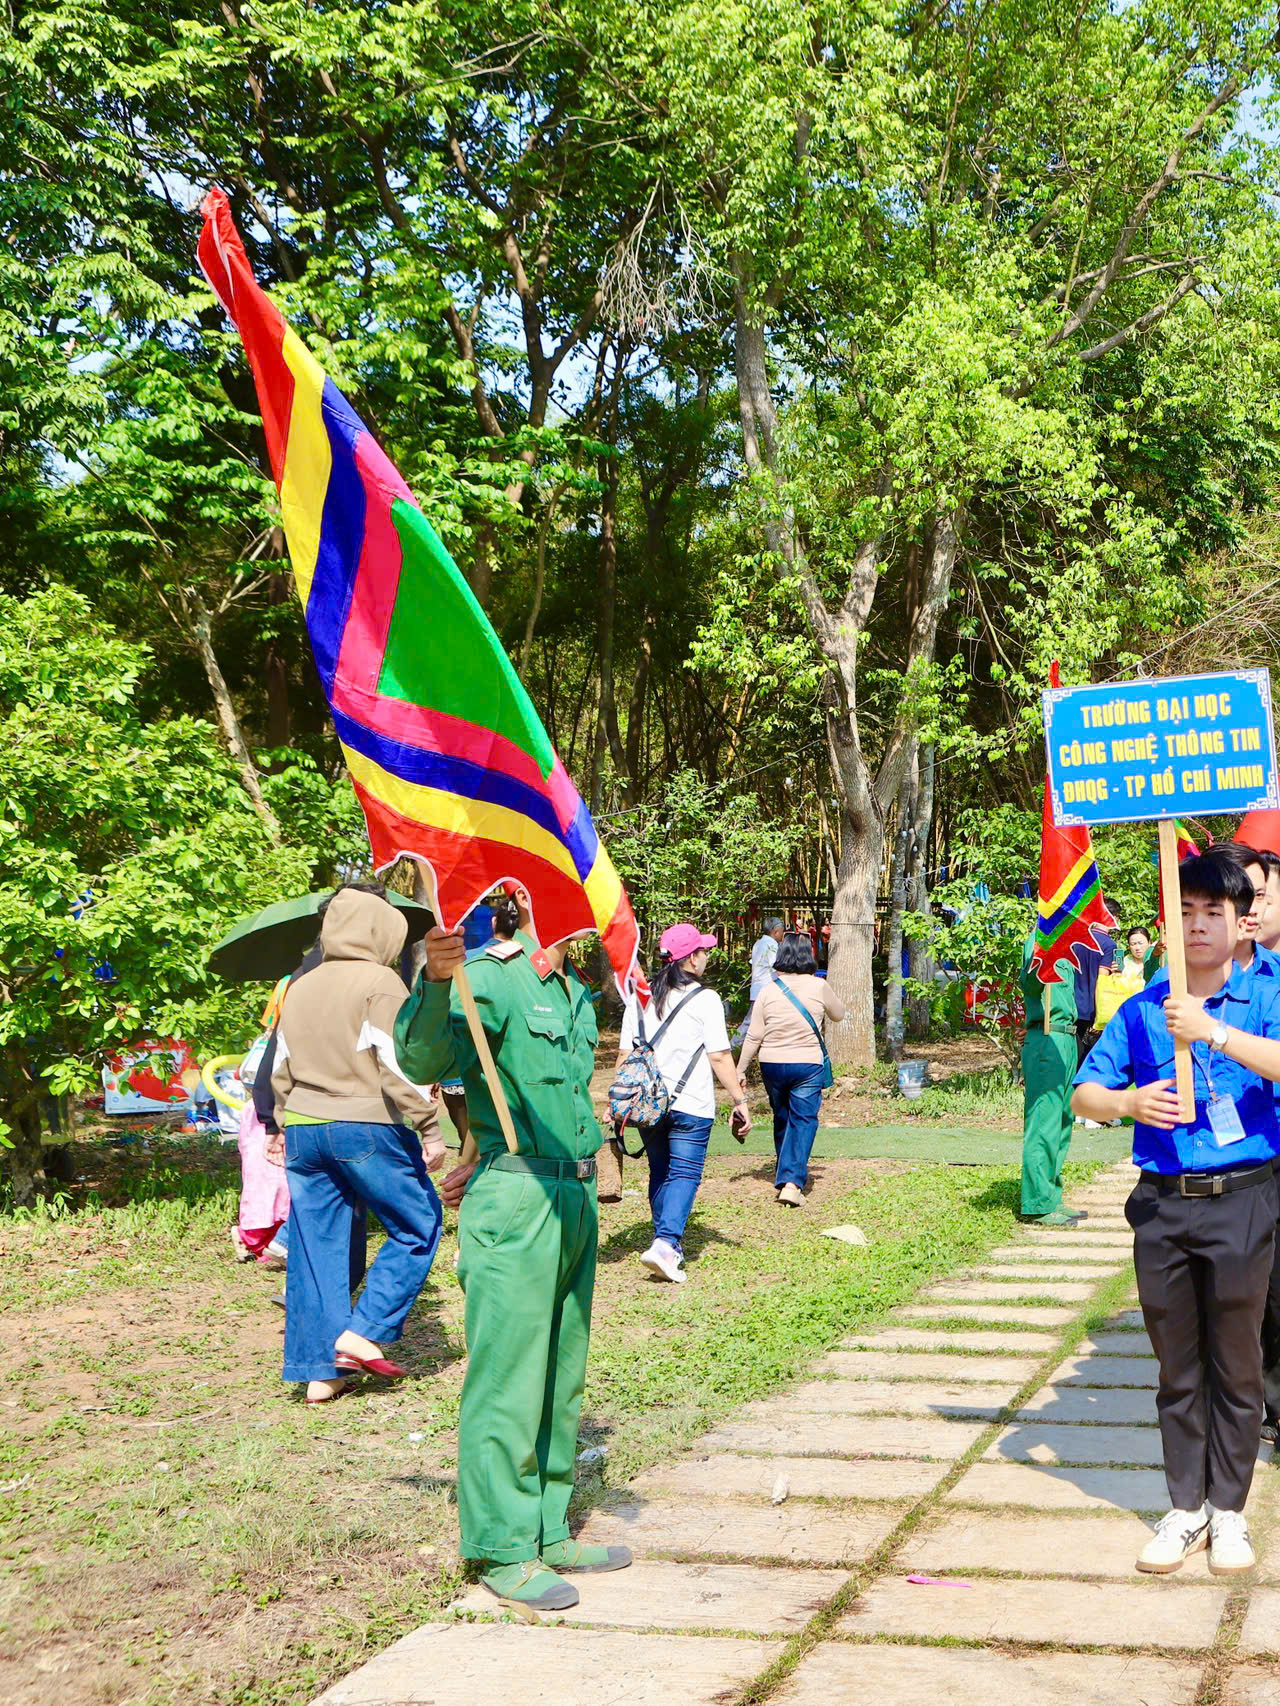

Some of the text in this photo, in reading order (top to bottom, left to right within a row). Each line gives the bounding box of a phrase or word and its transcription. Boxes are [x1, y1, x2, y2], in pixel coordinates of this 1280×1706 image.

[1080, 693, 1231, 728] TRƯỜNG ĐẠI HỌC
[1059, 728, 1260, 767] CÔNG NGHỆ THÔNG TIN
[1063, 778, 1108, 805] ĐHQG
[1124, 775, 1145, 798] TP
[1182, 765, 1211, 793] CHÍ
[1216, 764, 1264, 791] MINH
